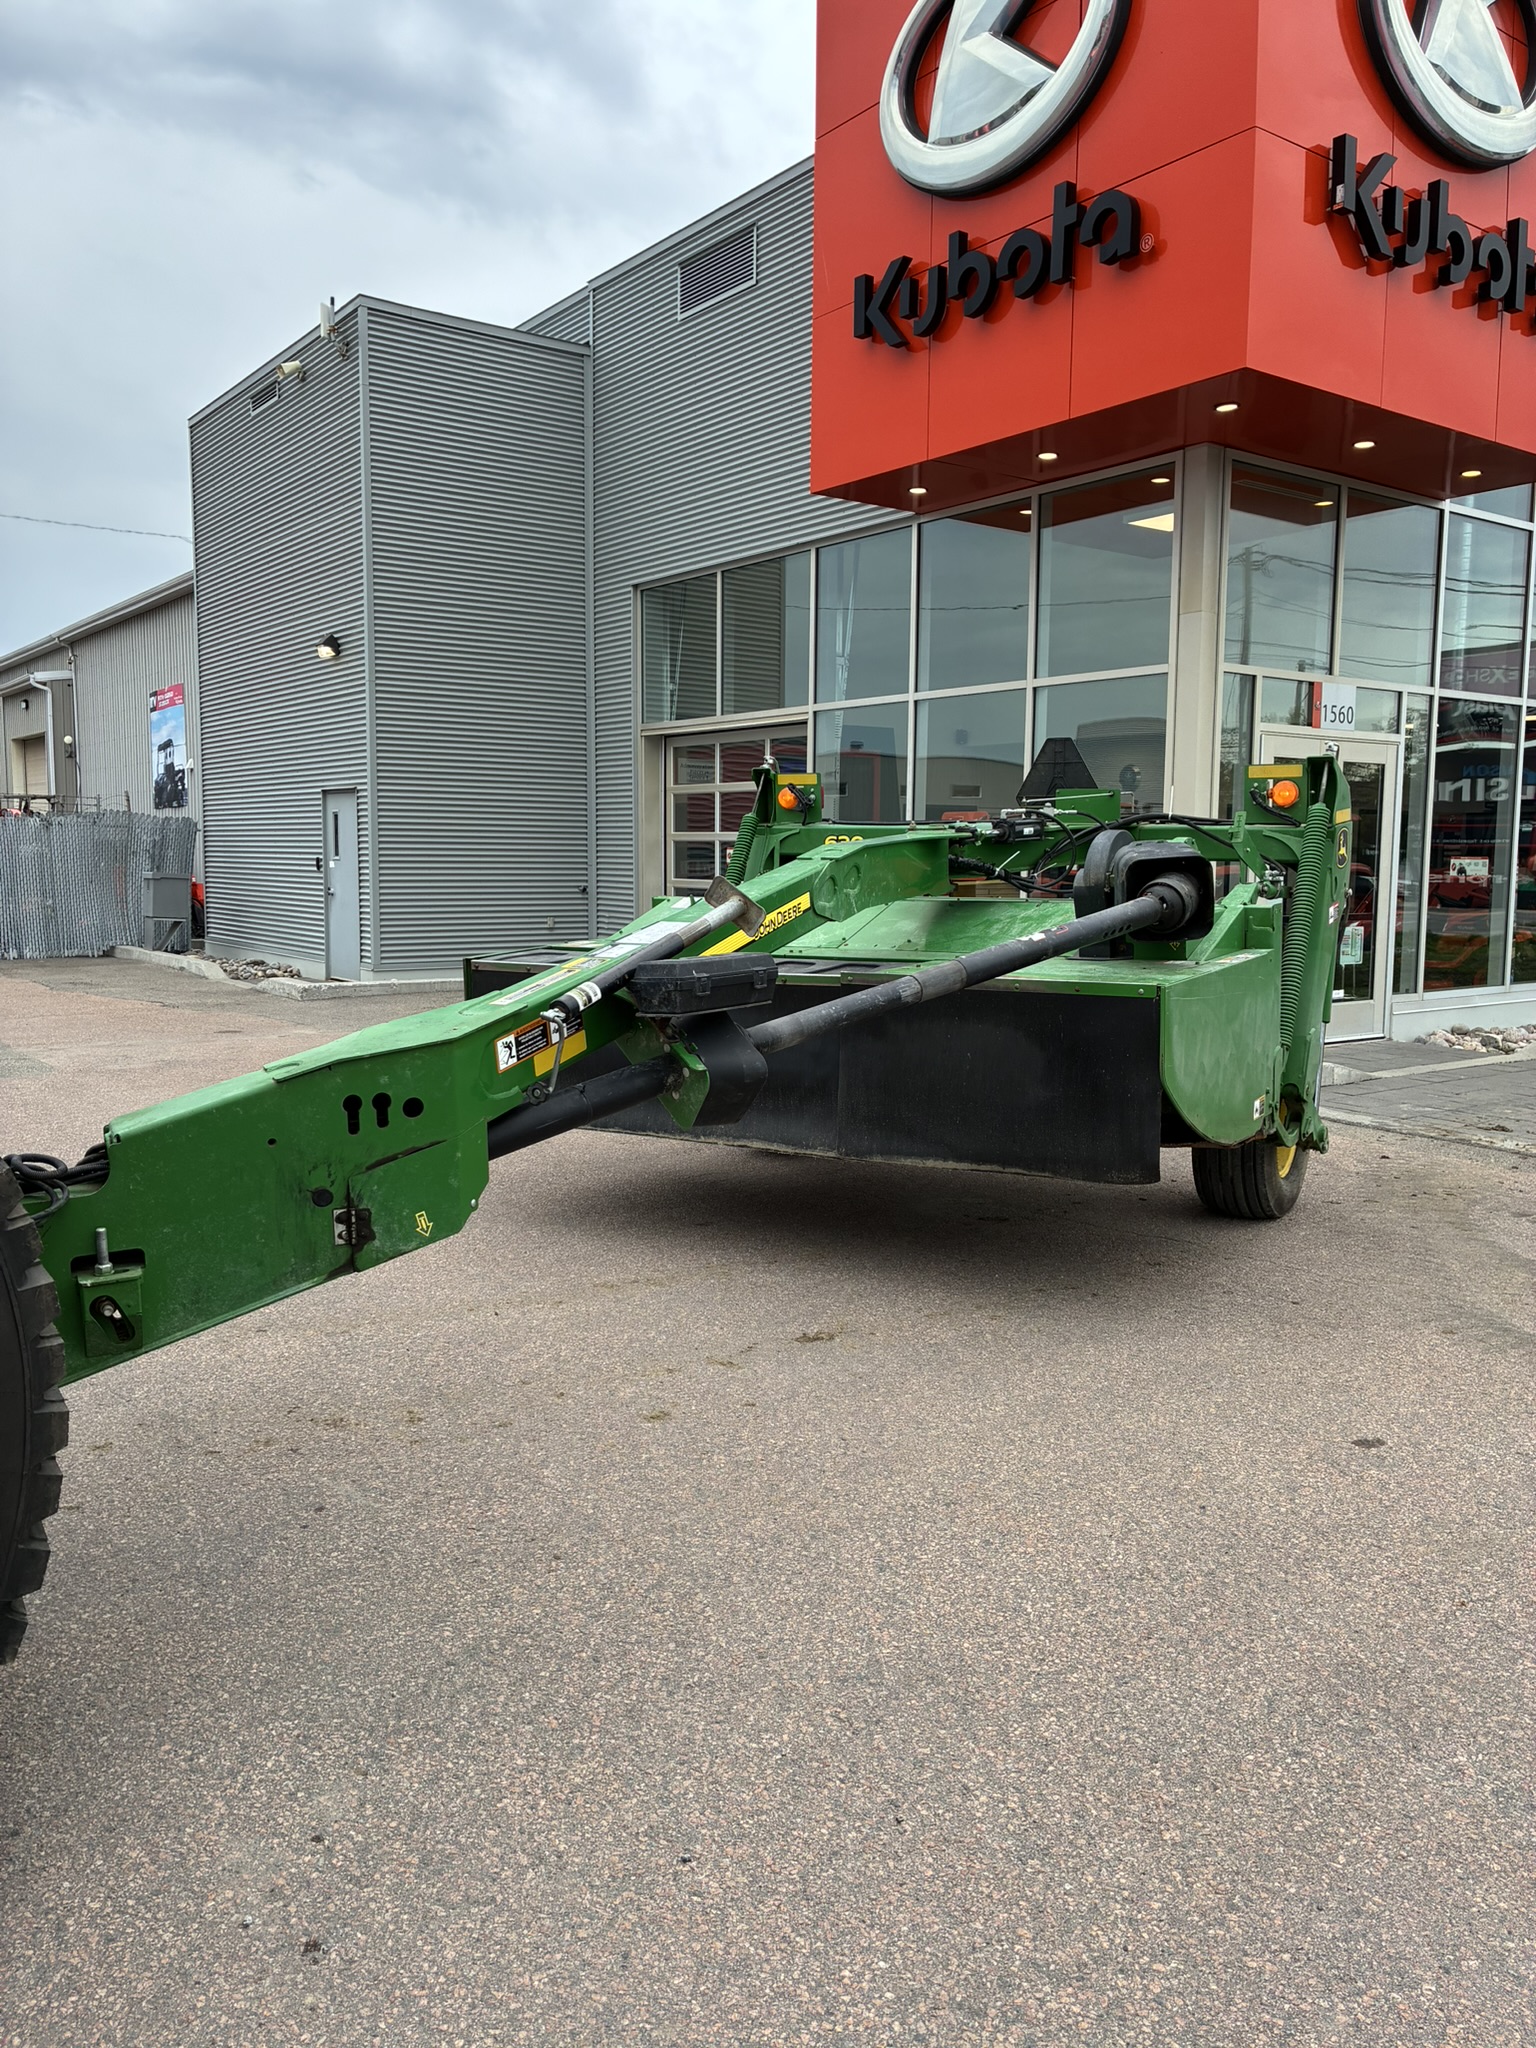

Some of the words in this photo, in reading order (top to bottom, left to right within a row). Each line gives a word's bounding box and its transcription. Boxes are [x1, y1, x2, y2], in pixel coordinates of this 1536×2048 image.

[854, 180, 1141, 348] Kubota
[1331, 133, 1536, 315] Kubot
[1323, 704, 1354, 725] 1560
[776, 902, 803, 926] DEERE
